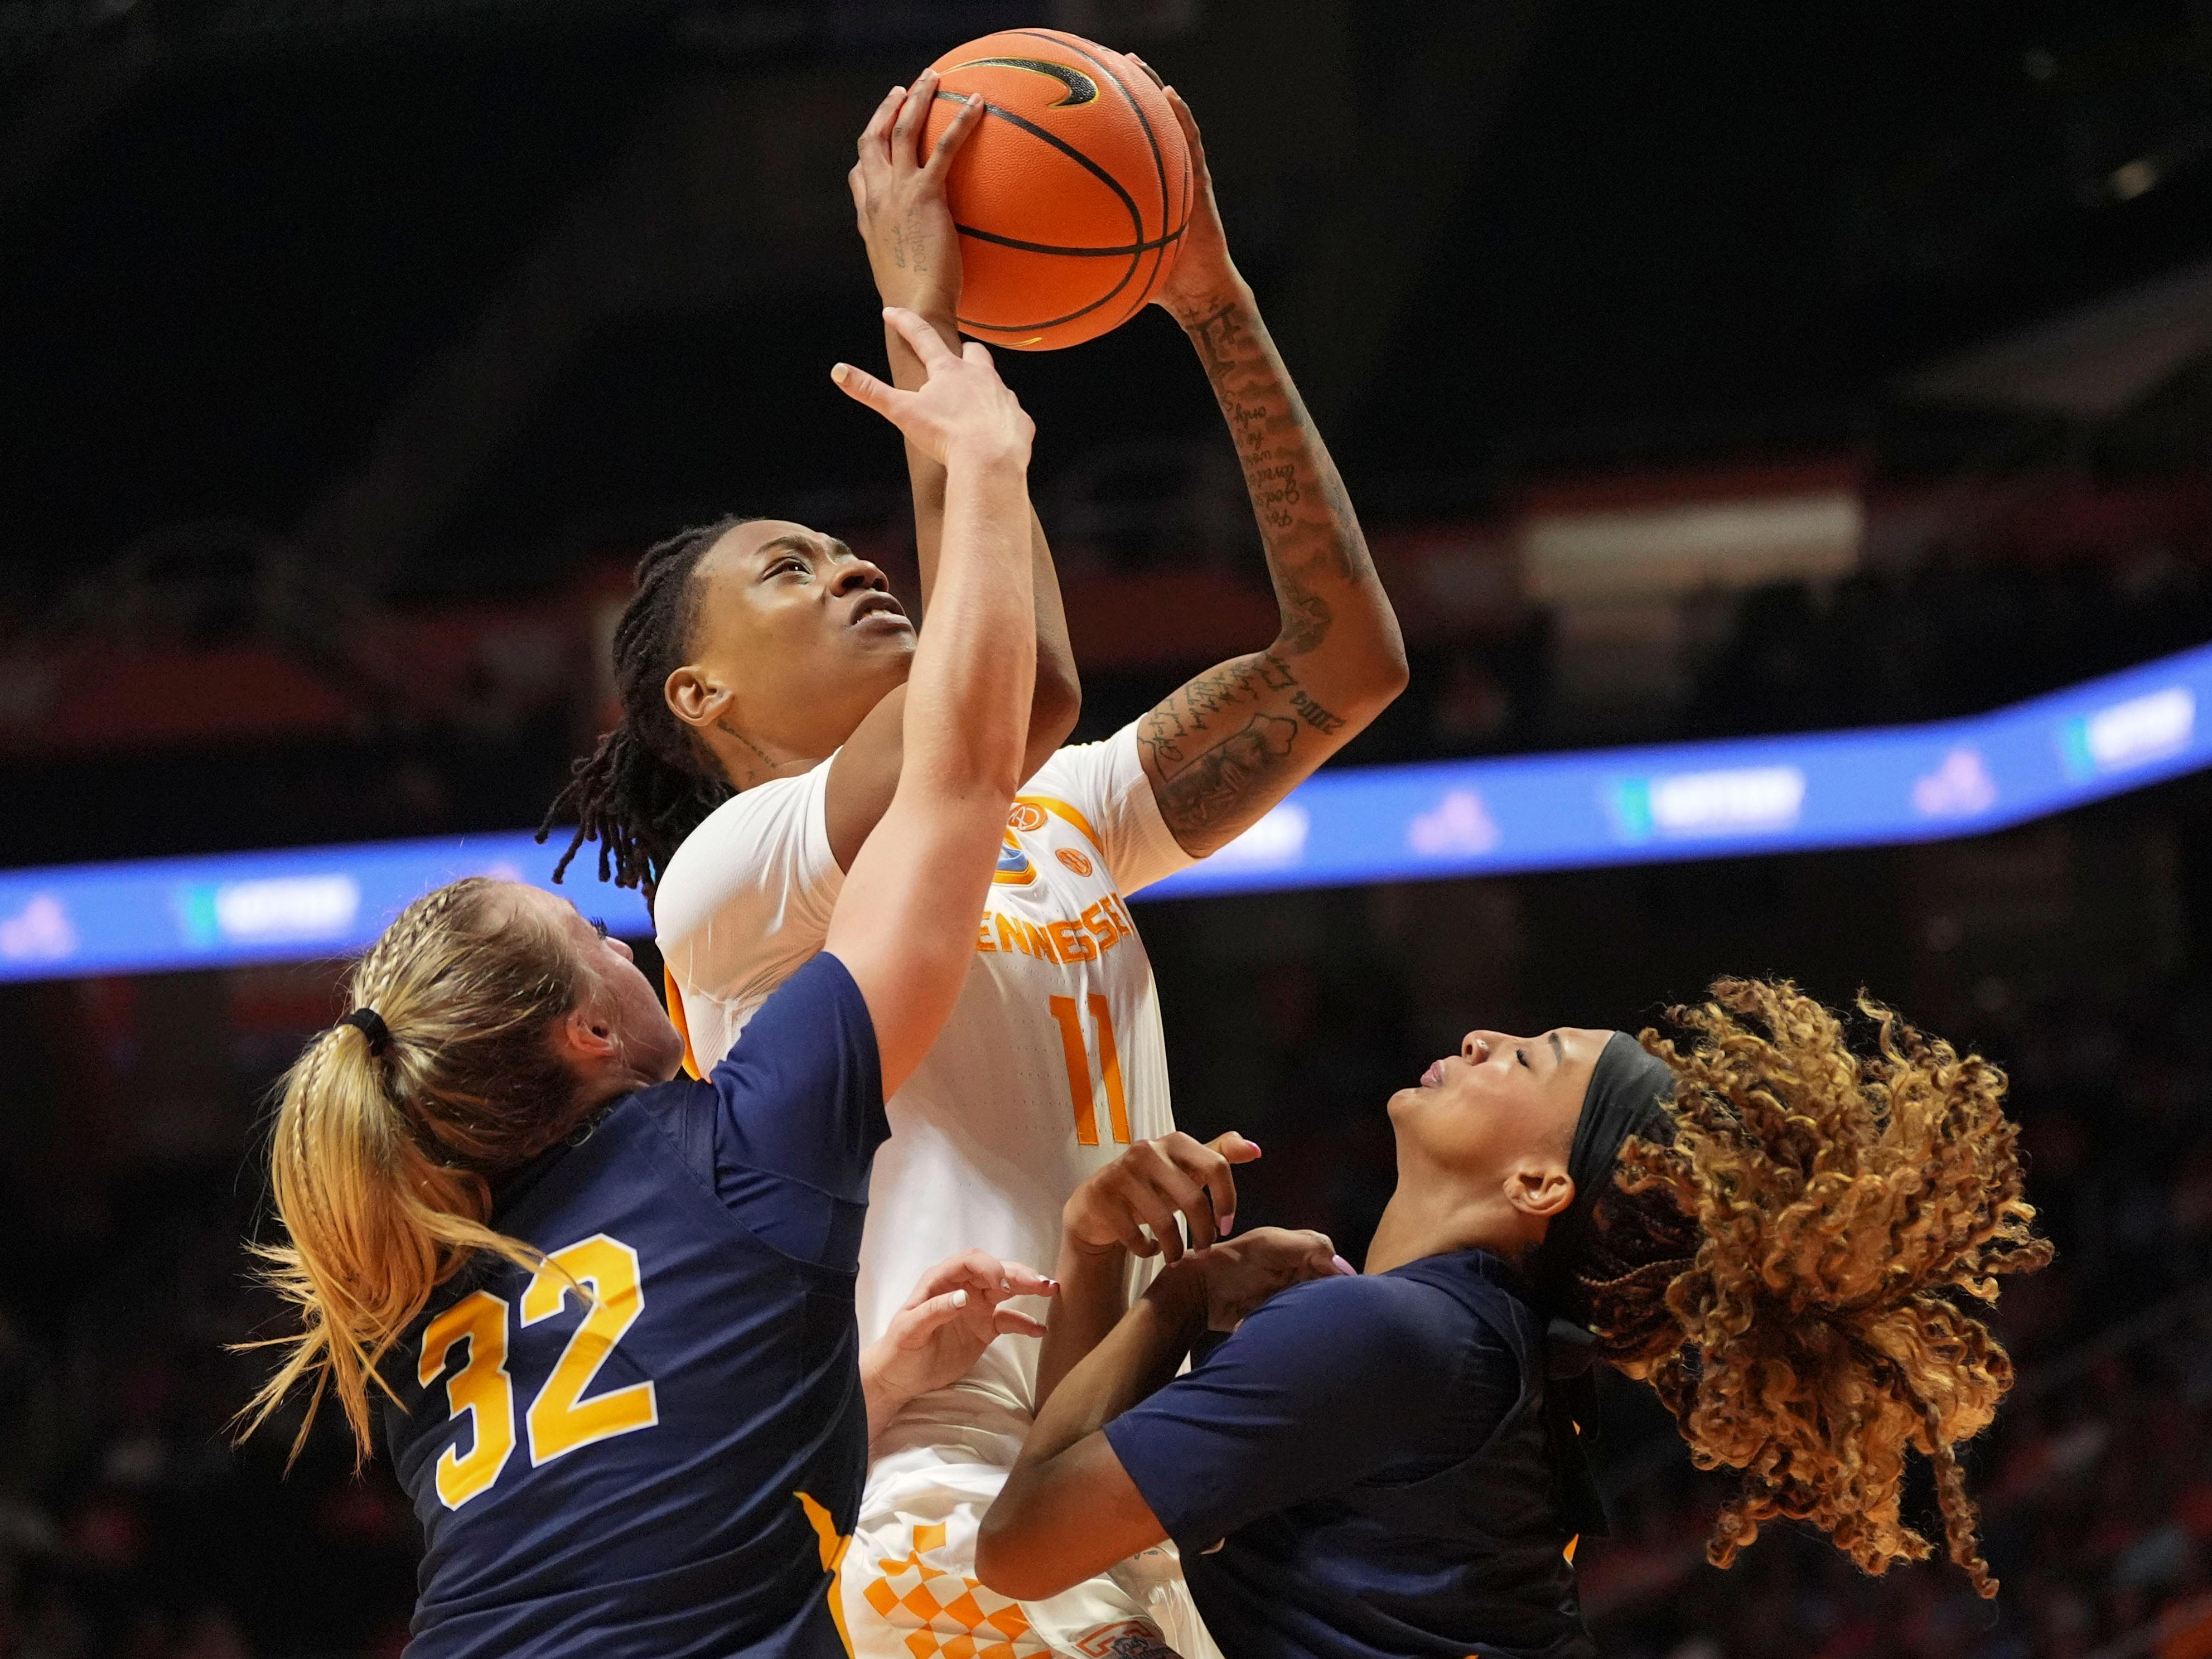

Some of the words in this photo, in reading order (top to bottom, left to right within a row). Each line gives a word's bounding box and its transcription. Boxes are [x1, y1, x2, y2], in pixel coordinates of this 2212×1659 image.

[977, 892, 1134, 964] ENNESSE
[1049, 994, 1131, 1145] 11
[417, 1232, 659, 1511] 32
